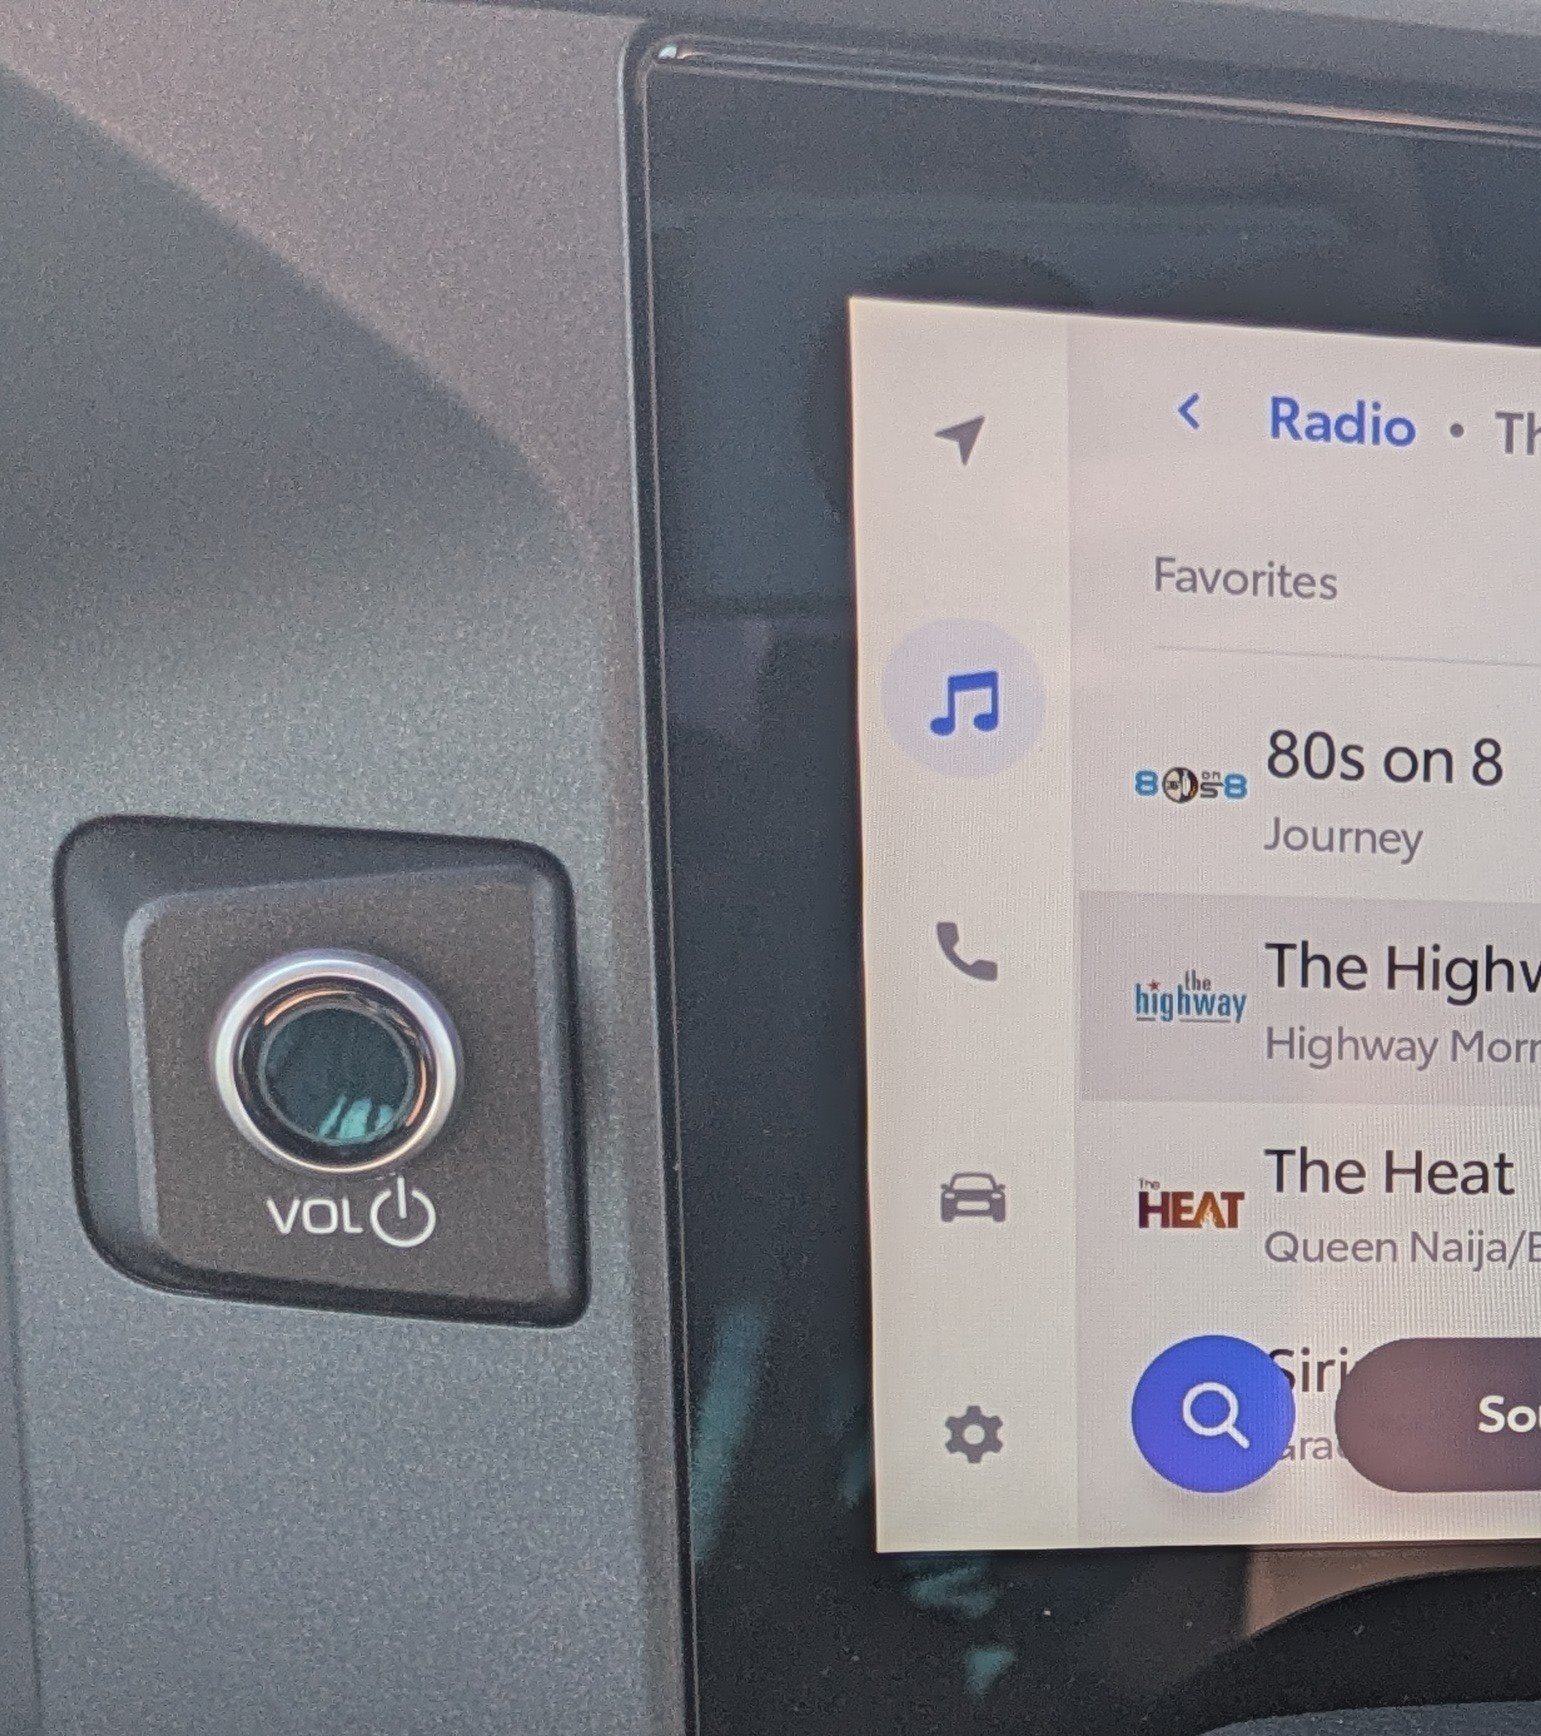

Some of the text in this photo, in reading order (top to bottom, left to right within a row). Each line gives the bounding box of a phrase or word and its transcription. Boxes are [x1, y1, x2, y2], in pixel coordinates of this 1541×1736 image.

[1269, 397, 1416, 451] Radio
[1154, 556, 1338, 603] Favorites
[1266, 730, 1504, 788] 80s on 8
[1264, 815, 1424, 864] Journey
[1185, 970, 1212, 991] the
[1265, 941, 1368, 991] The
[1135, 984, 1247, 1024] highway
[1266, 1026, 1438, 1071] Highway
[1264, 1147, 1514, 1196] The Heat
[266, 1198, 364, 1235] VOL
[1139, 1191, 1245, 1228] HEAT
[1264, 1228, 1399, 1267] Queen
